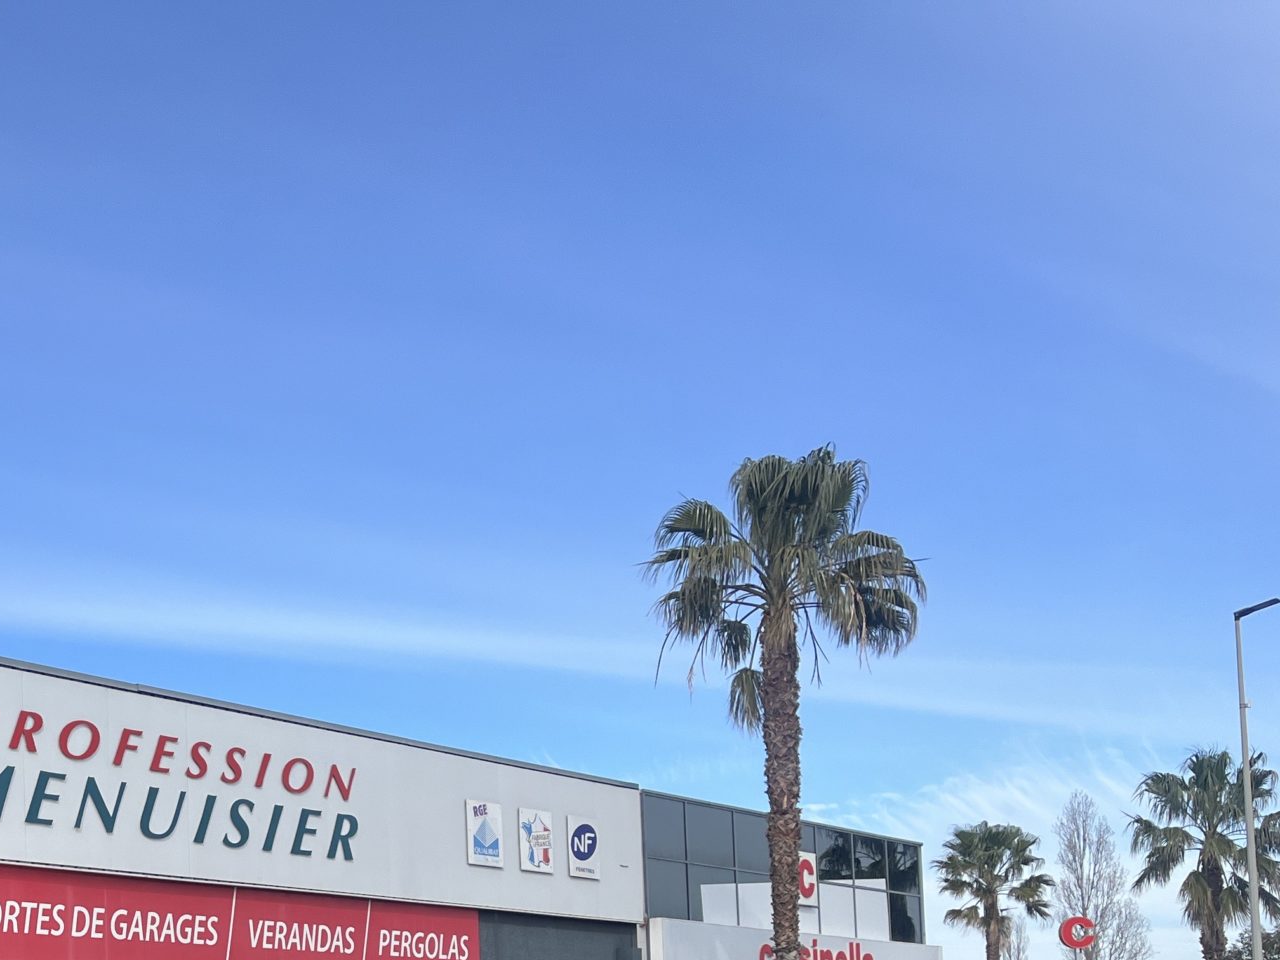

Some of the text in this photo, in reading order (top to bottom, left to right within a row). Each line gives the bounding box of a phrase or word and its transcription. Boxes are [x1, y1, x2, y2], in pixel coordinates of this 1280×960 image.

[473, 804, 488, 817] RGE
[574, 832, 595, 853] NF
[70, 907, 104, 939] DE
[109, 909, 218, 946] GARAGES
[248, 918, 355, 955] VERANDAS
[378, 929, 469, 960] PERGOLAS
